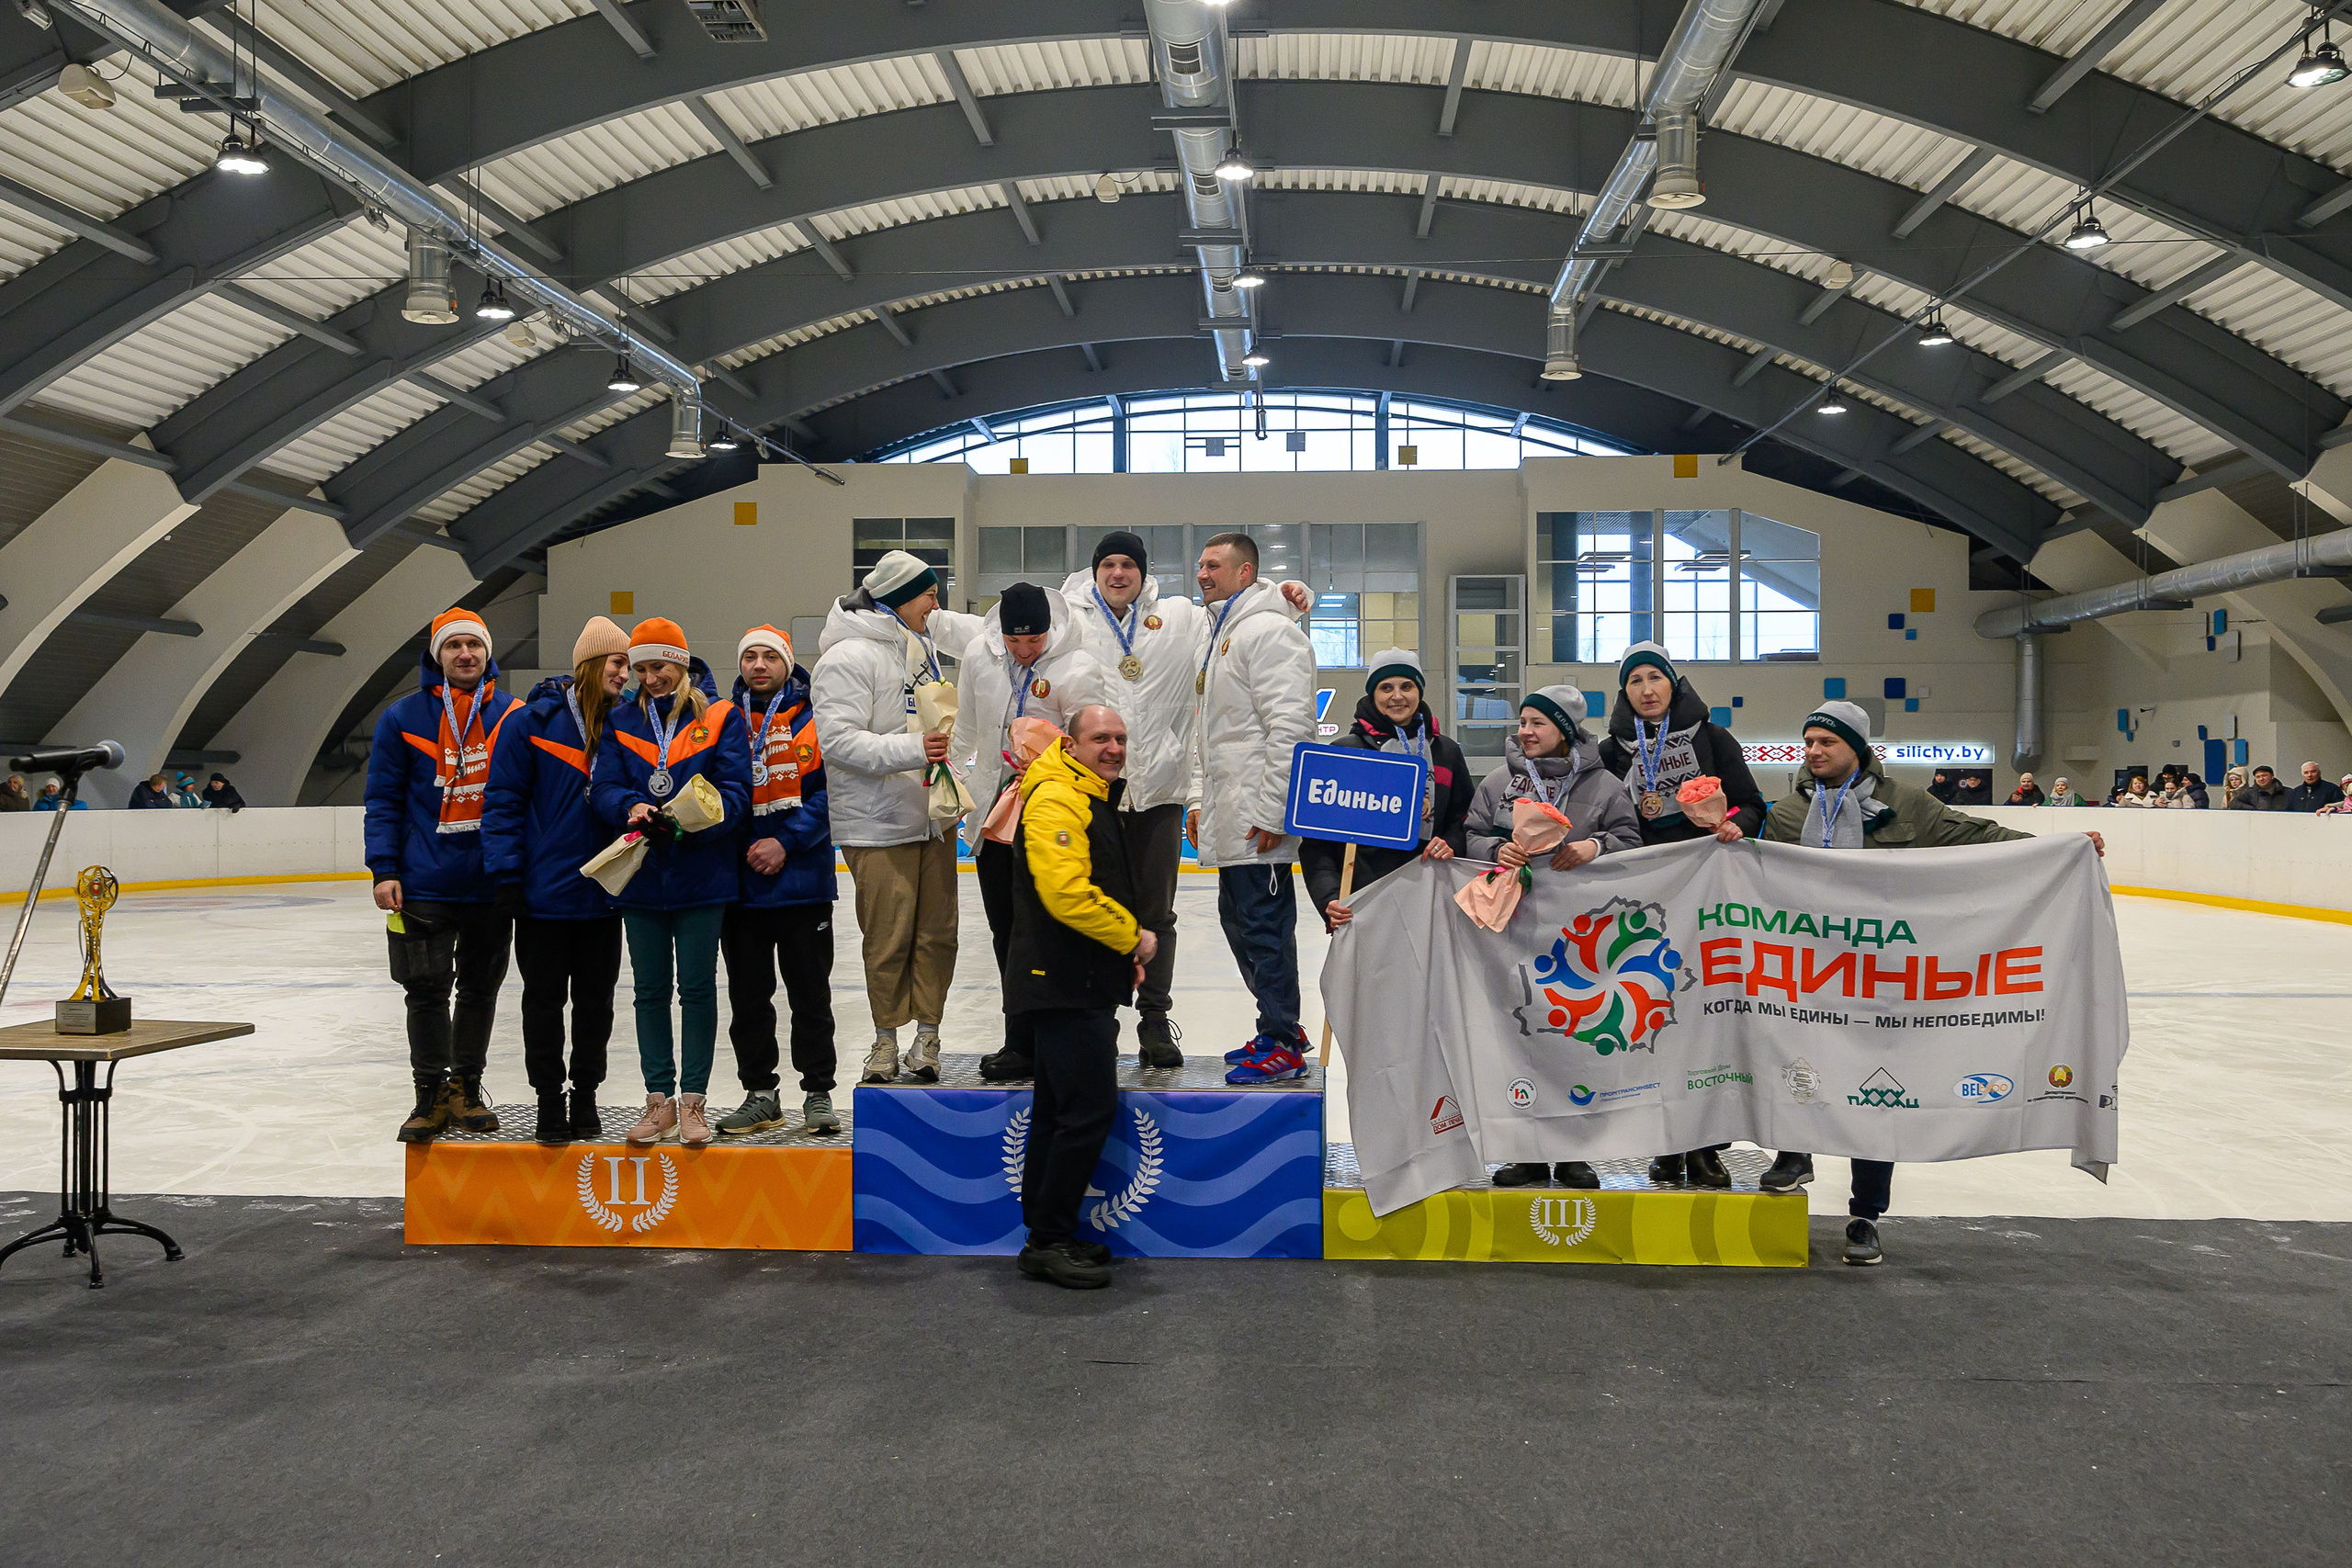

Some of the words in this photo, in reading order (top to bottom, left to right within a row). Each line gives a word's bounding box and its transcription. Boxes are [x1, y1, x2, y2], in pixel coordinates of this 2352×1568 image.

[1637, 751, 1692, 777] ЕИНЫЕ
[1896, 745, 1984, 761] silichy.by
[1307, 778, 1402, 814] Единые
[1698, 902, 1917, 950] КОМАНДА
[1699, 936, 2044, 1004] ЕДИНЫЕ
[1703, 998, 1752, 1016] КОГДА
[1758, 1002, 1786, 1018] МЫ
[1790, 1007, 1849, 1026] ЕДИНЫ
[1875, 1015, 1907, 1028] МЫ
[1913, 1008, 2046, 1029] НЕПОБЕДИМЫ!
[1687, 1072, 1754, 1090] ВОСТОЧНЫЙ
